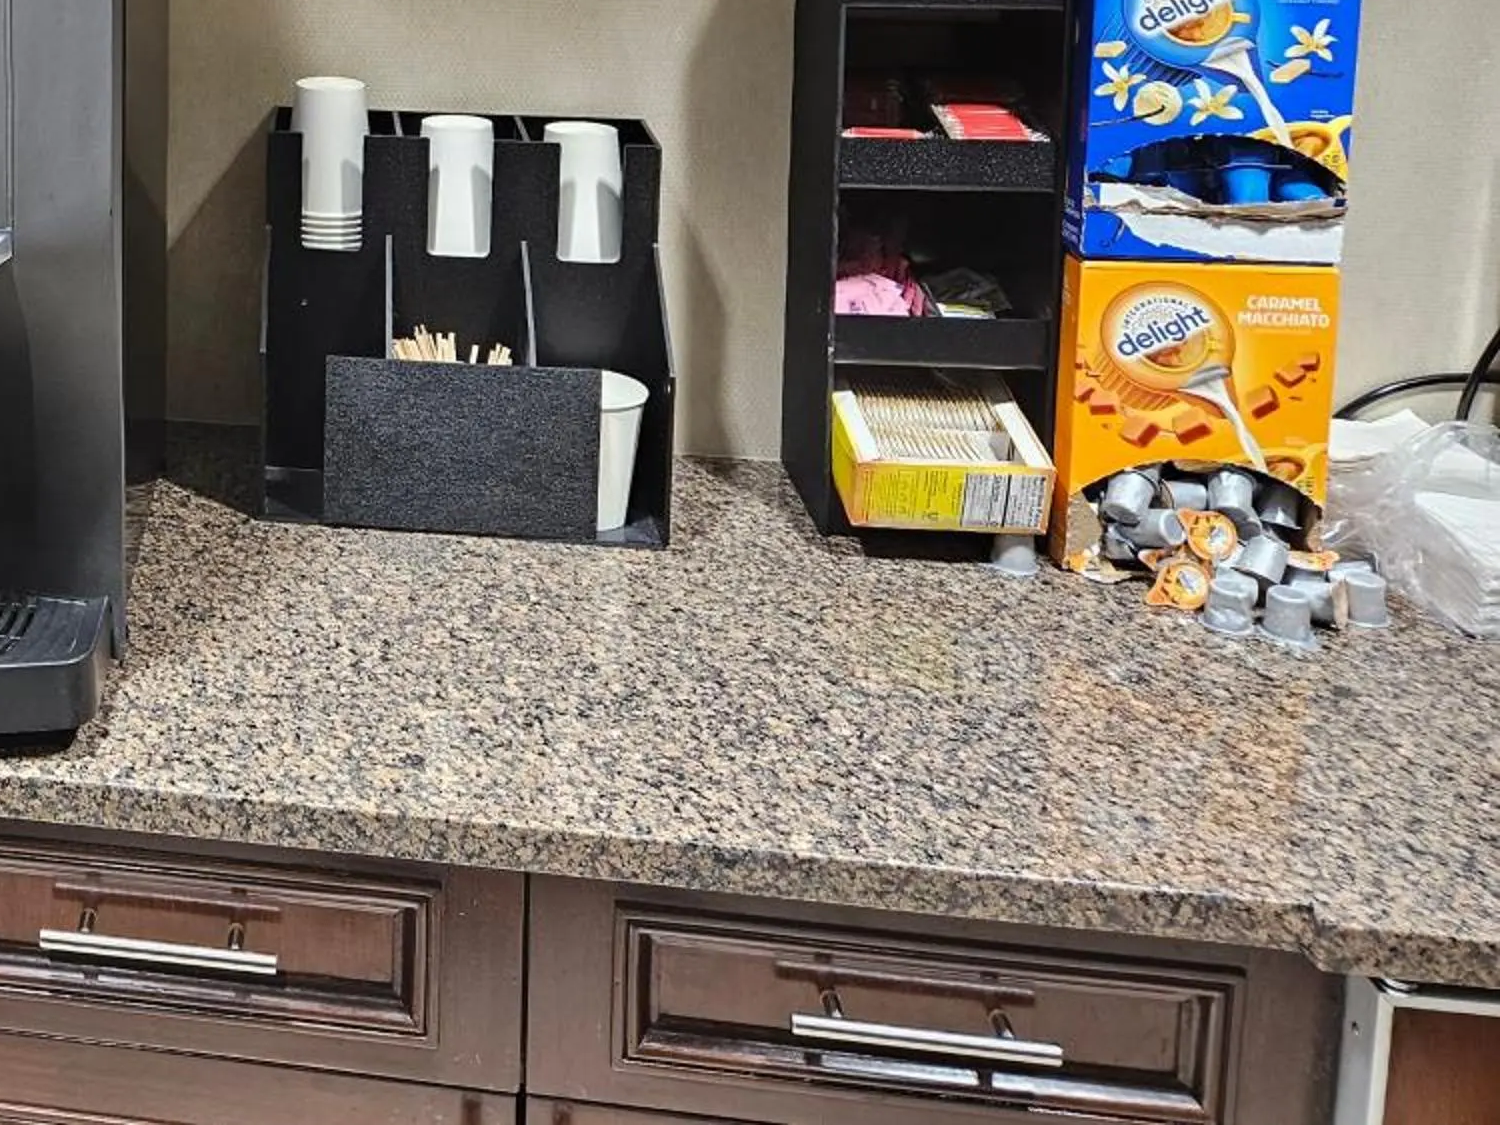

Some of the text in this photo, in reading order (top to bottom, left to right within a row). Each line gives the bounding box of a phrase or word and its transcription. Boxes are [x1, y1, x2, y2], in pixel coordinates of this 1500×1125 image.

[1246, 295, 1323, 312] CARAMEL
[1237, 311, 1331, 329] MACCHIATO
[1117, 306, 1211, 356] delight
